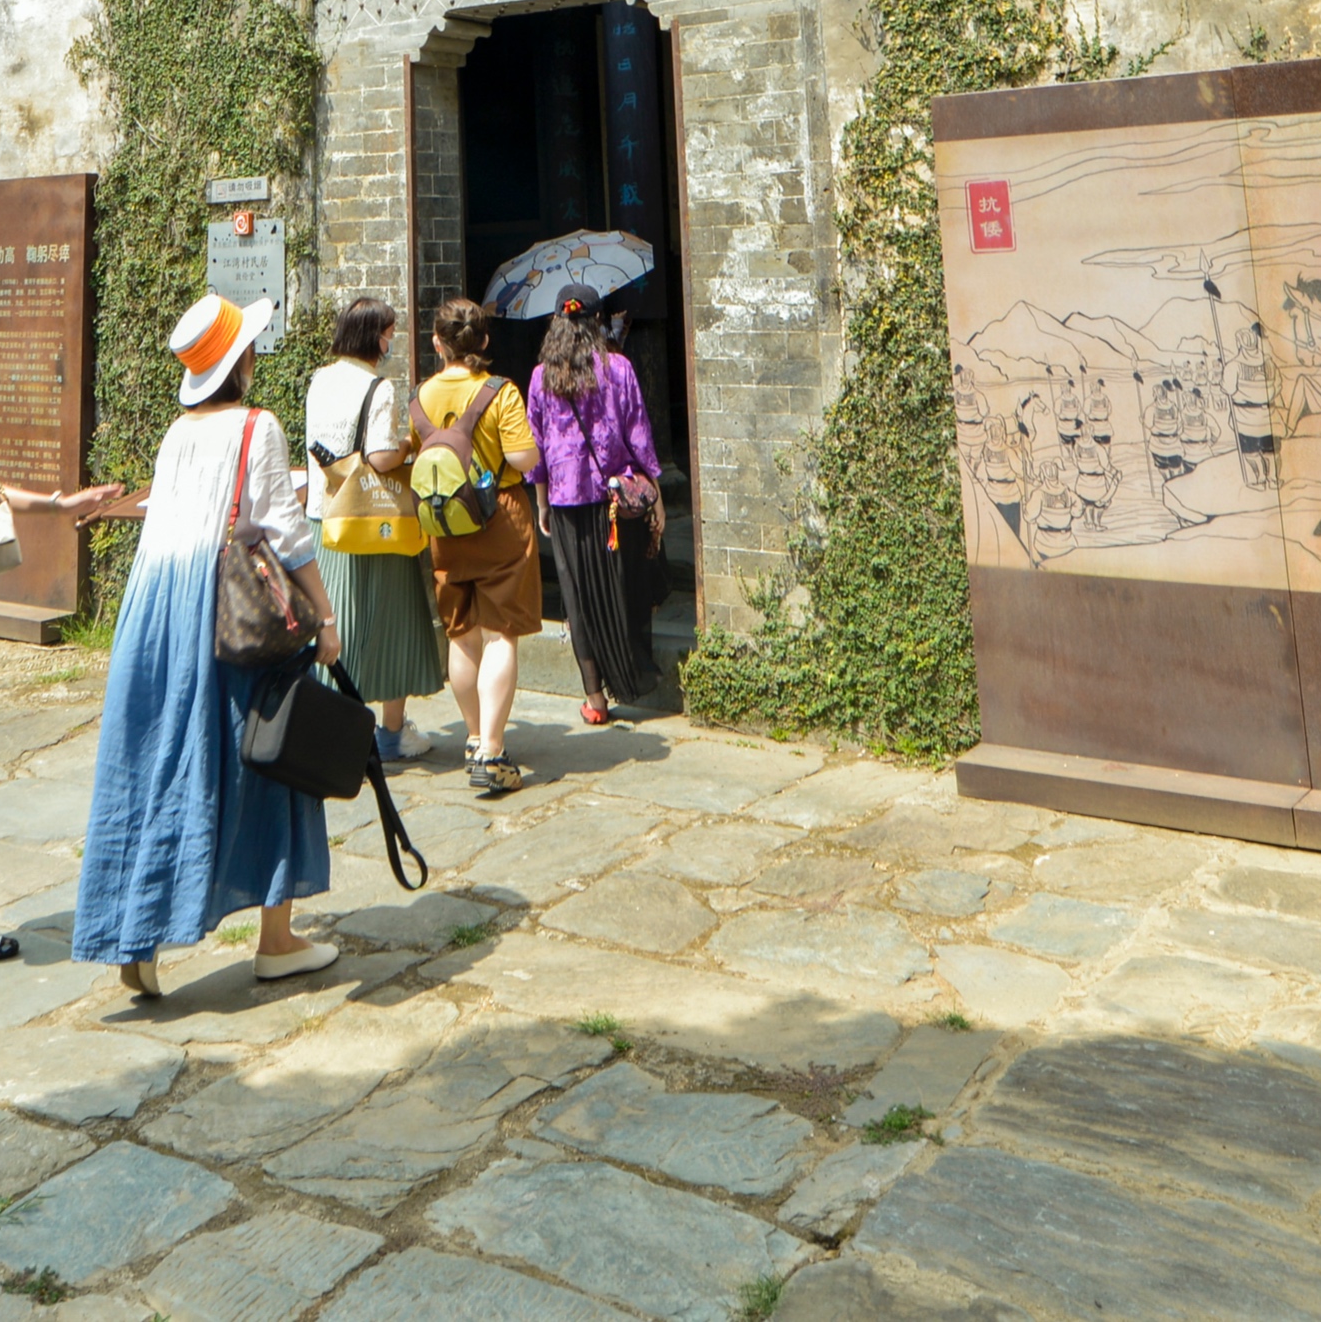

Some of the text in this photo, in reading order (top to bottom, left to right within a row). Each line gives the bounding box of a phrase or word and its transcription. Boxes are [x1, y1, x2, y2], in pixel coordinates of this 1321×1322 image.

[979, 196, 1003, 238] 抗倭
[26, 243, 70, 264] 鞠躬尽瘁
